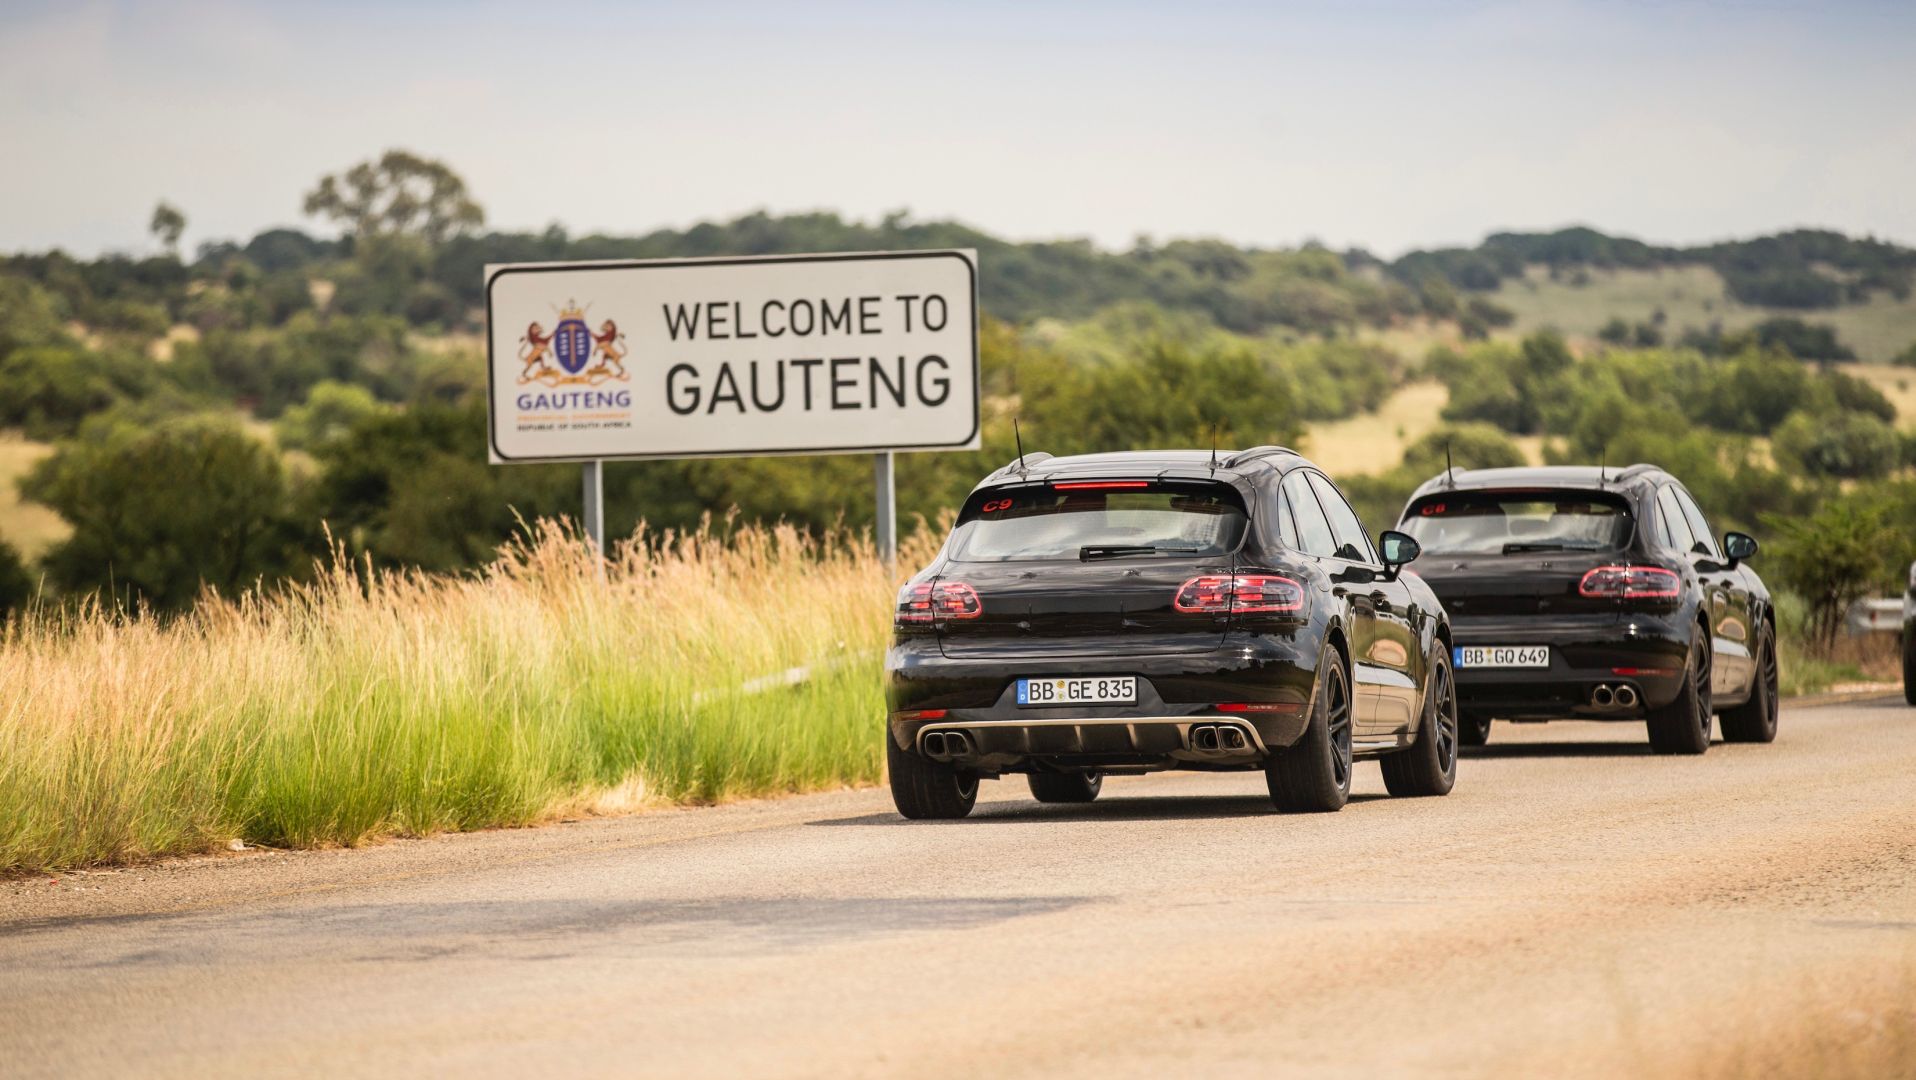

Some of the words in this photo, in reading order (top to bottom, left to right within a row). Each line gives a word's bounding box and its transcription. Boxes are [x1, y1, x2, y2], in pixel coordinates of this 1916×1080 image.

[663, 298, 882, 340] WELCOME
[896, 294, 948, 333] TO
[666, 355, 951, 416] GAUTENG
[517, 390, 631, 411] GAUTENG
[982, 498, 1013, 513] C9
[1463, 649, 1484, 664] BB
[1494, 649, 1515, 664] GQ
[1518, 649, 1547, 664] 649
[1030, 682, 1054, 700] BB
[1069, 681, 1092, 699] GE
[1098, 680, 1133, 698] 835
